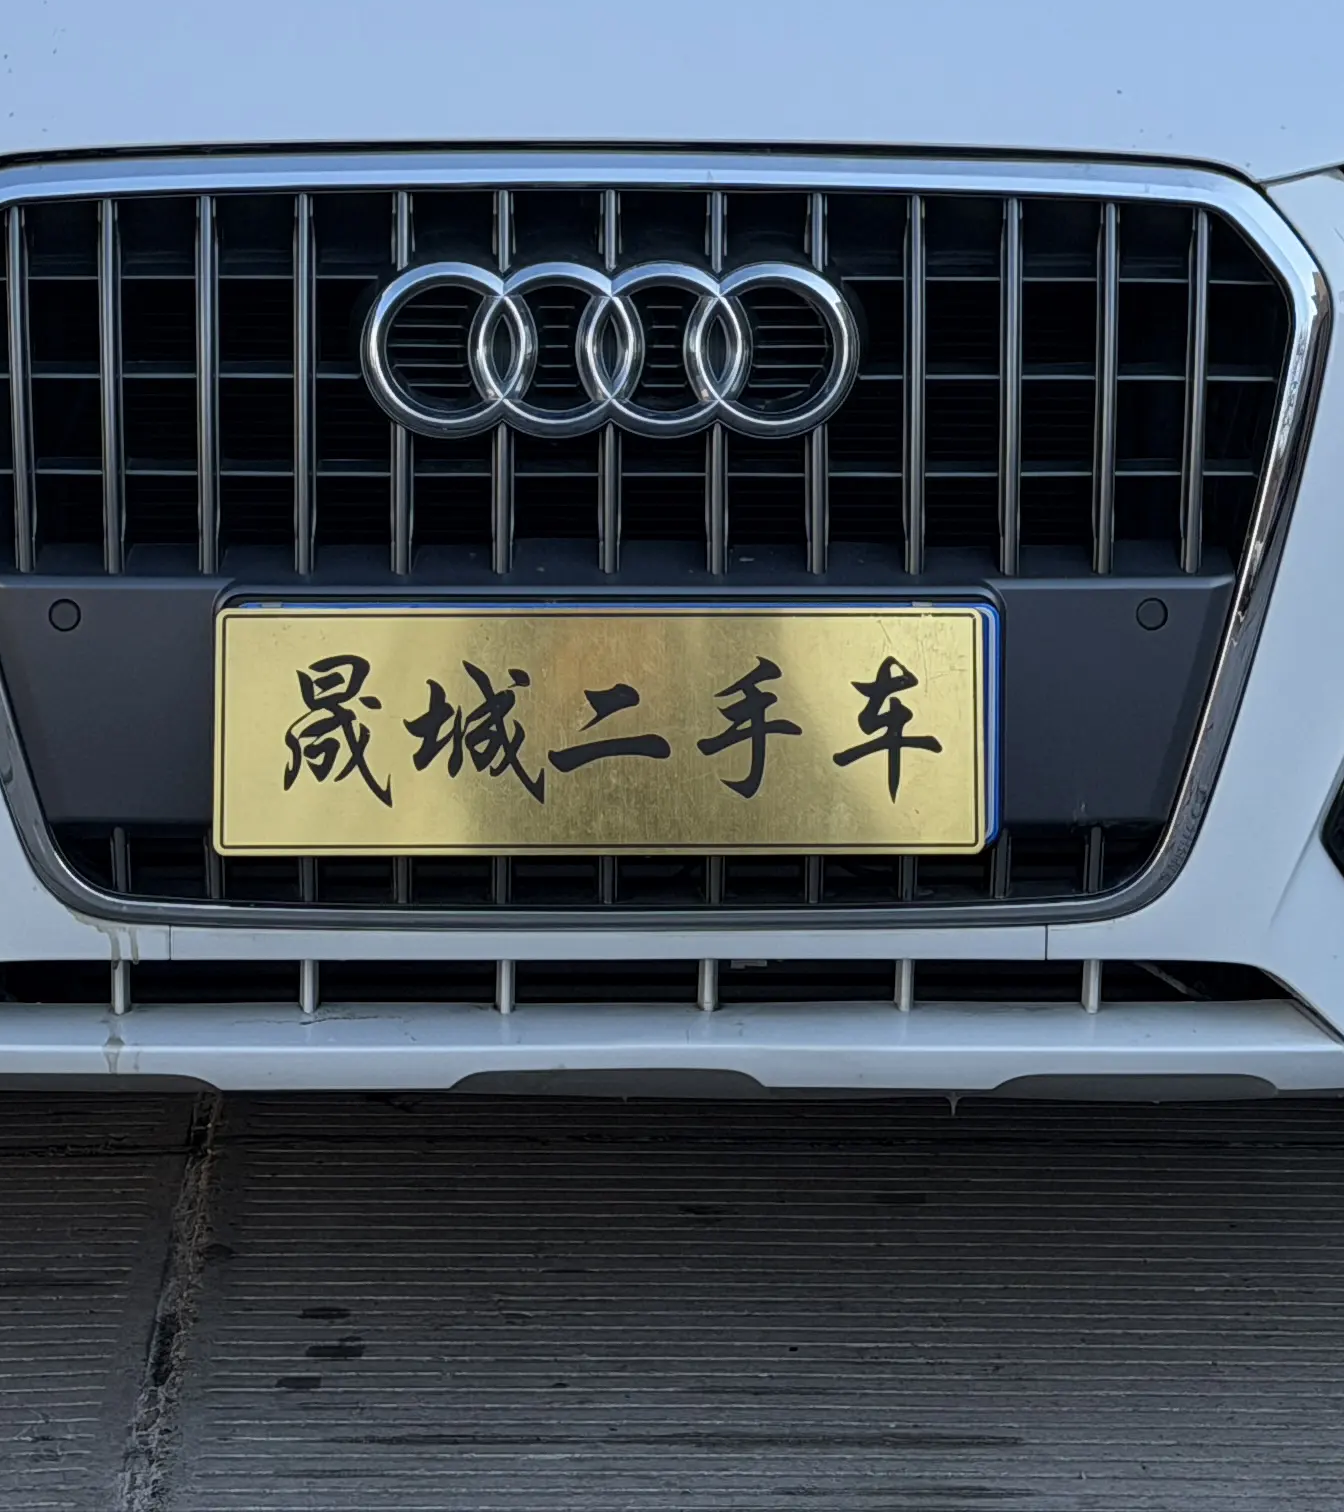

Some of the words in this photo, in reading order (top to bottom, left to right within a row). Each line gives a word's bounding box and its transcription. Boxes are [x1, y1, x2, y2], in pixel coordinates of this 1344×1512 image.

[282, 653, 943, 807] 晟城二手车
